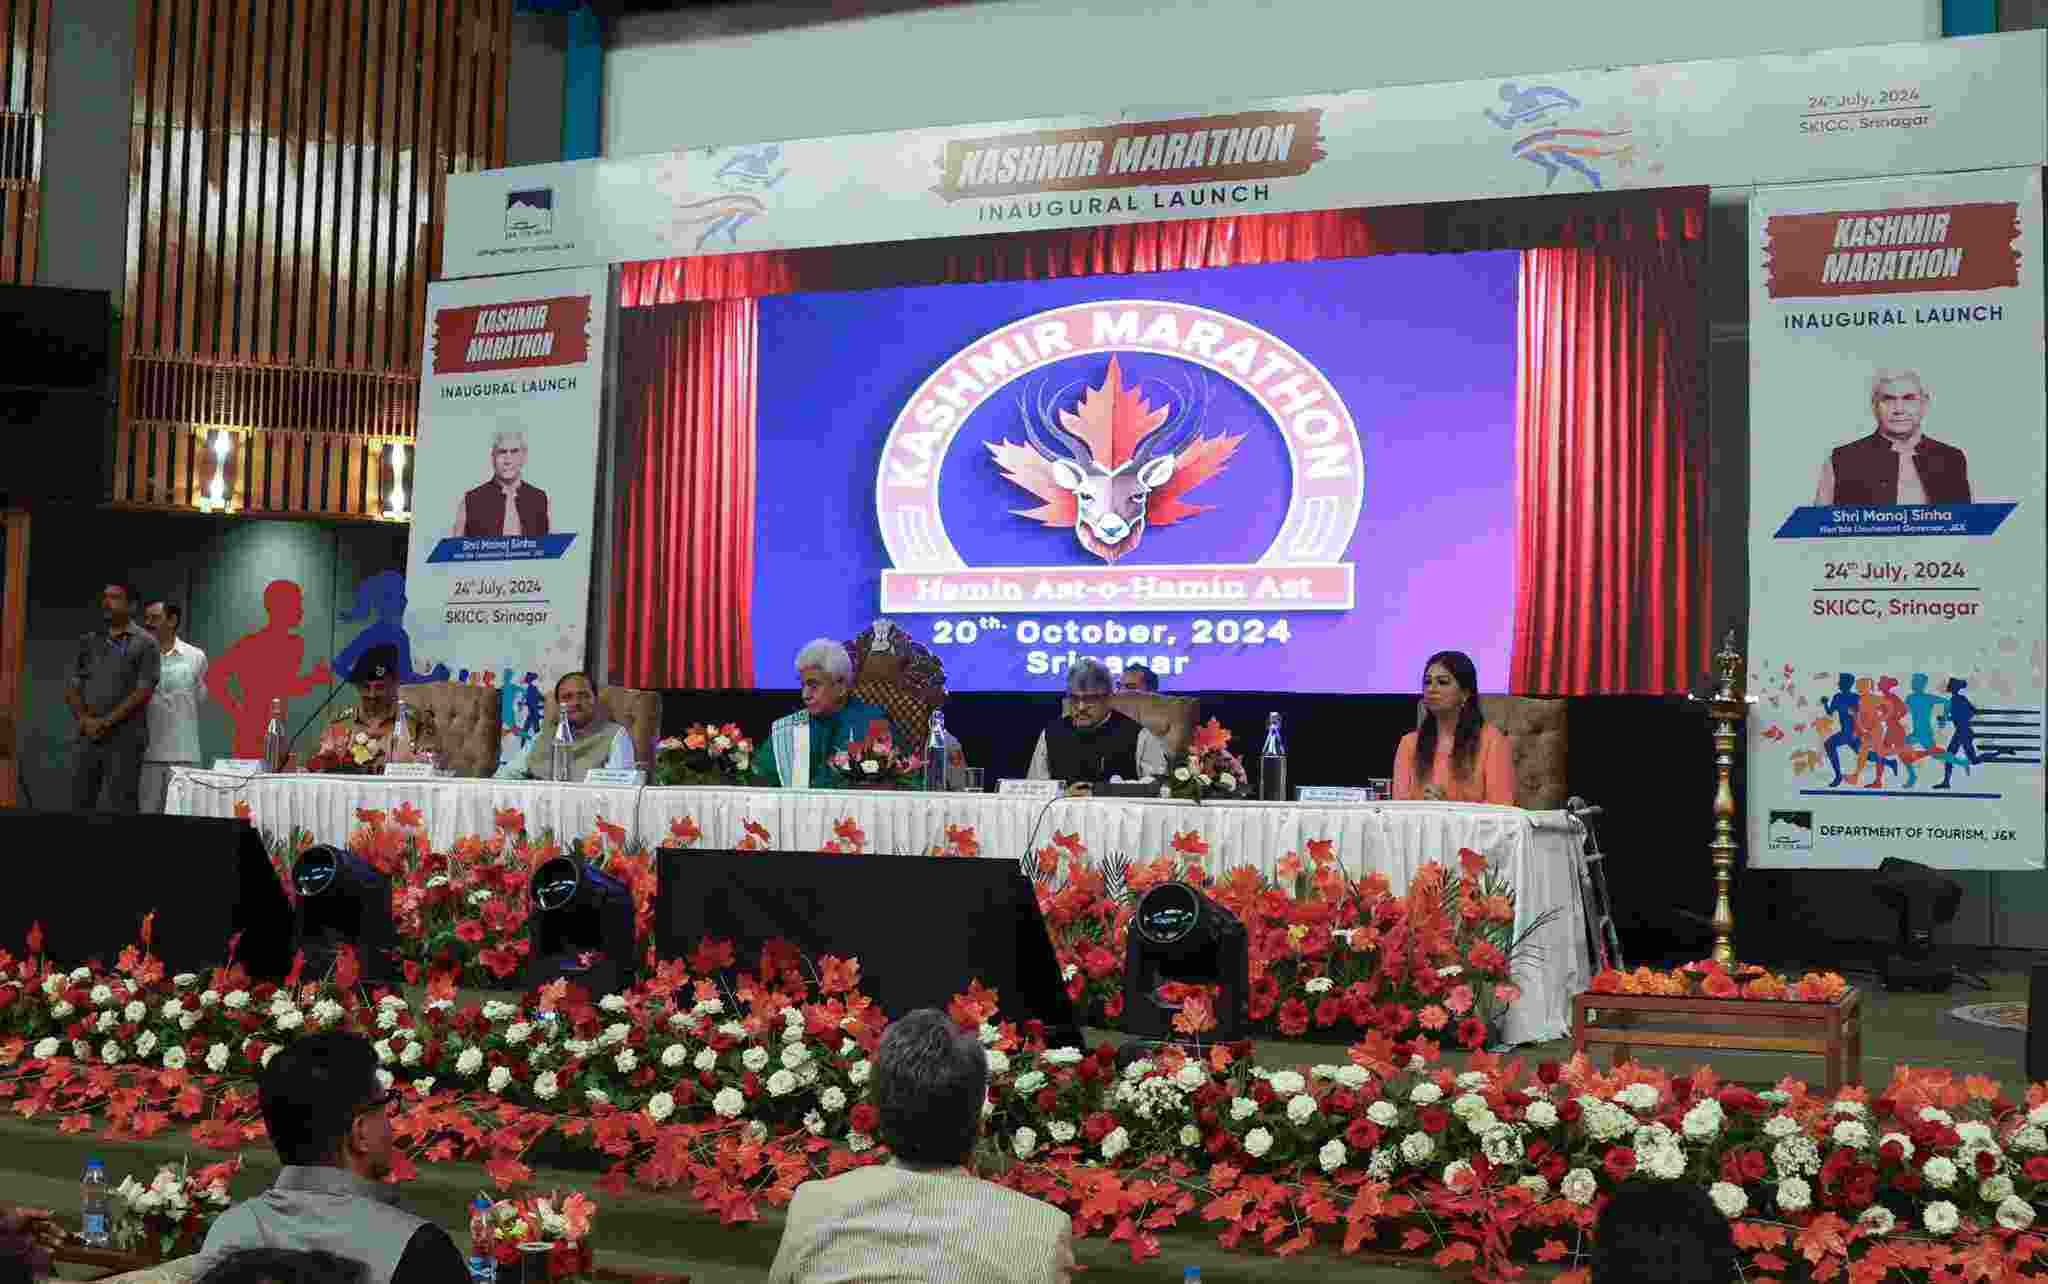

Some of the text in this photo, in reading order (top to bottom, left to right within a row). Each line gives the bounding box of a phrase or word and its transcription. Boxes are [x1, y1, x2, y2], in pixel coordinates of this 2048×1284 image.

[1879, 88, 1920, 103] 2024
[1859, 115, 1929, 130] Srinagar
[957, 122, 1297, 190] KASHMIR MARATHON
[978, 183, 1269, 221] INAUGURAL LAUNCH
[1832, 213, 1951, 249] KASHMIR
[1821, 247, 1963, 284] MARATHON
[474, 305, 549, 335] KASHMIR
[1784, 305, 2003, 329] INAUGURAL LAUNCH
[465, 331, 555, 362] MARATHON
[440, 377, 577, 399] INAUGURAL LAUNCH
[888, 310, 1352, 489] KASHMIR MARATHON
[1832, 509, 1953, 524] Shri Manoj Sinha
[1862, 561, 1908, 582] July,
[1914, 561, 1966, 579] 2024
[509, 579, 542, 593] 2024
[446, 610, 549, 626] SKICC, Srinagar
[1812, 598, 1979, 619] SKICC, Srinagar
[1016, 619, 1177, 646] October,
[1191, 618, 1292, 645] 2024
[1026, 650, 1191, 675] Sriagar
[1820, 825, 2017, 842] DEPARTMENT OF TOURISM, J&K
